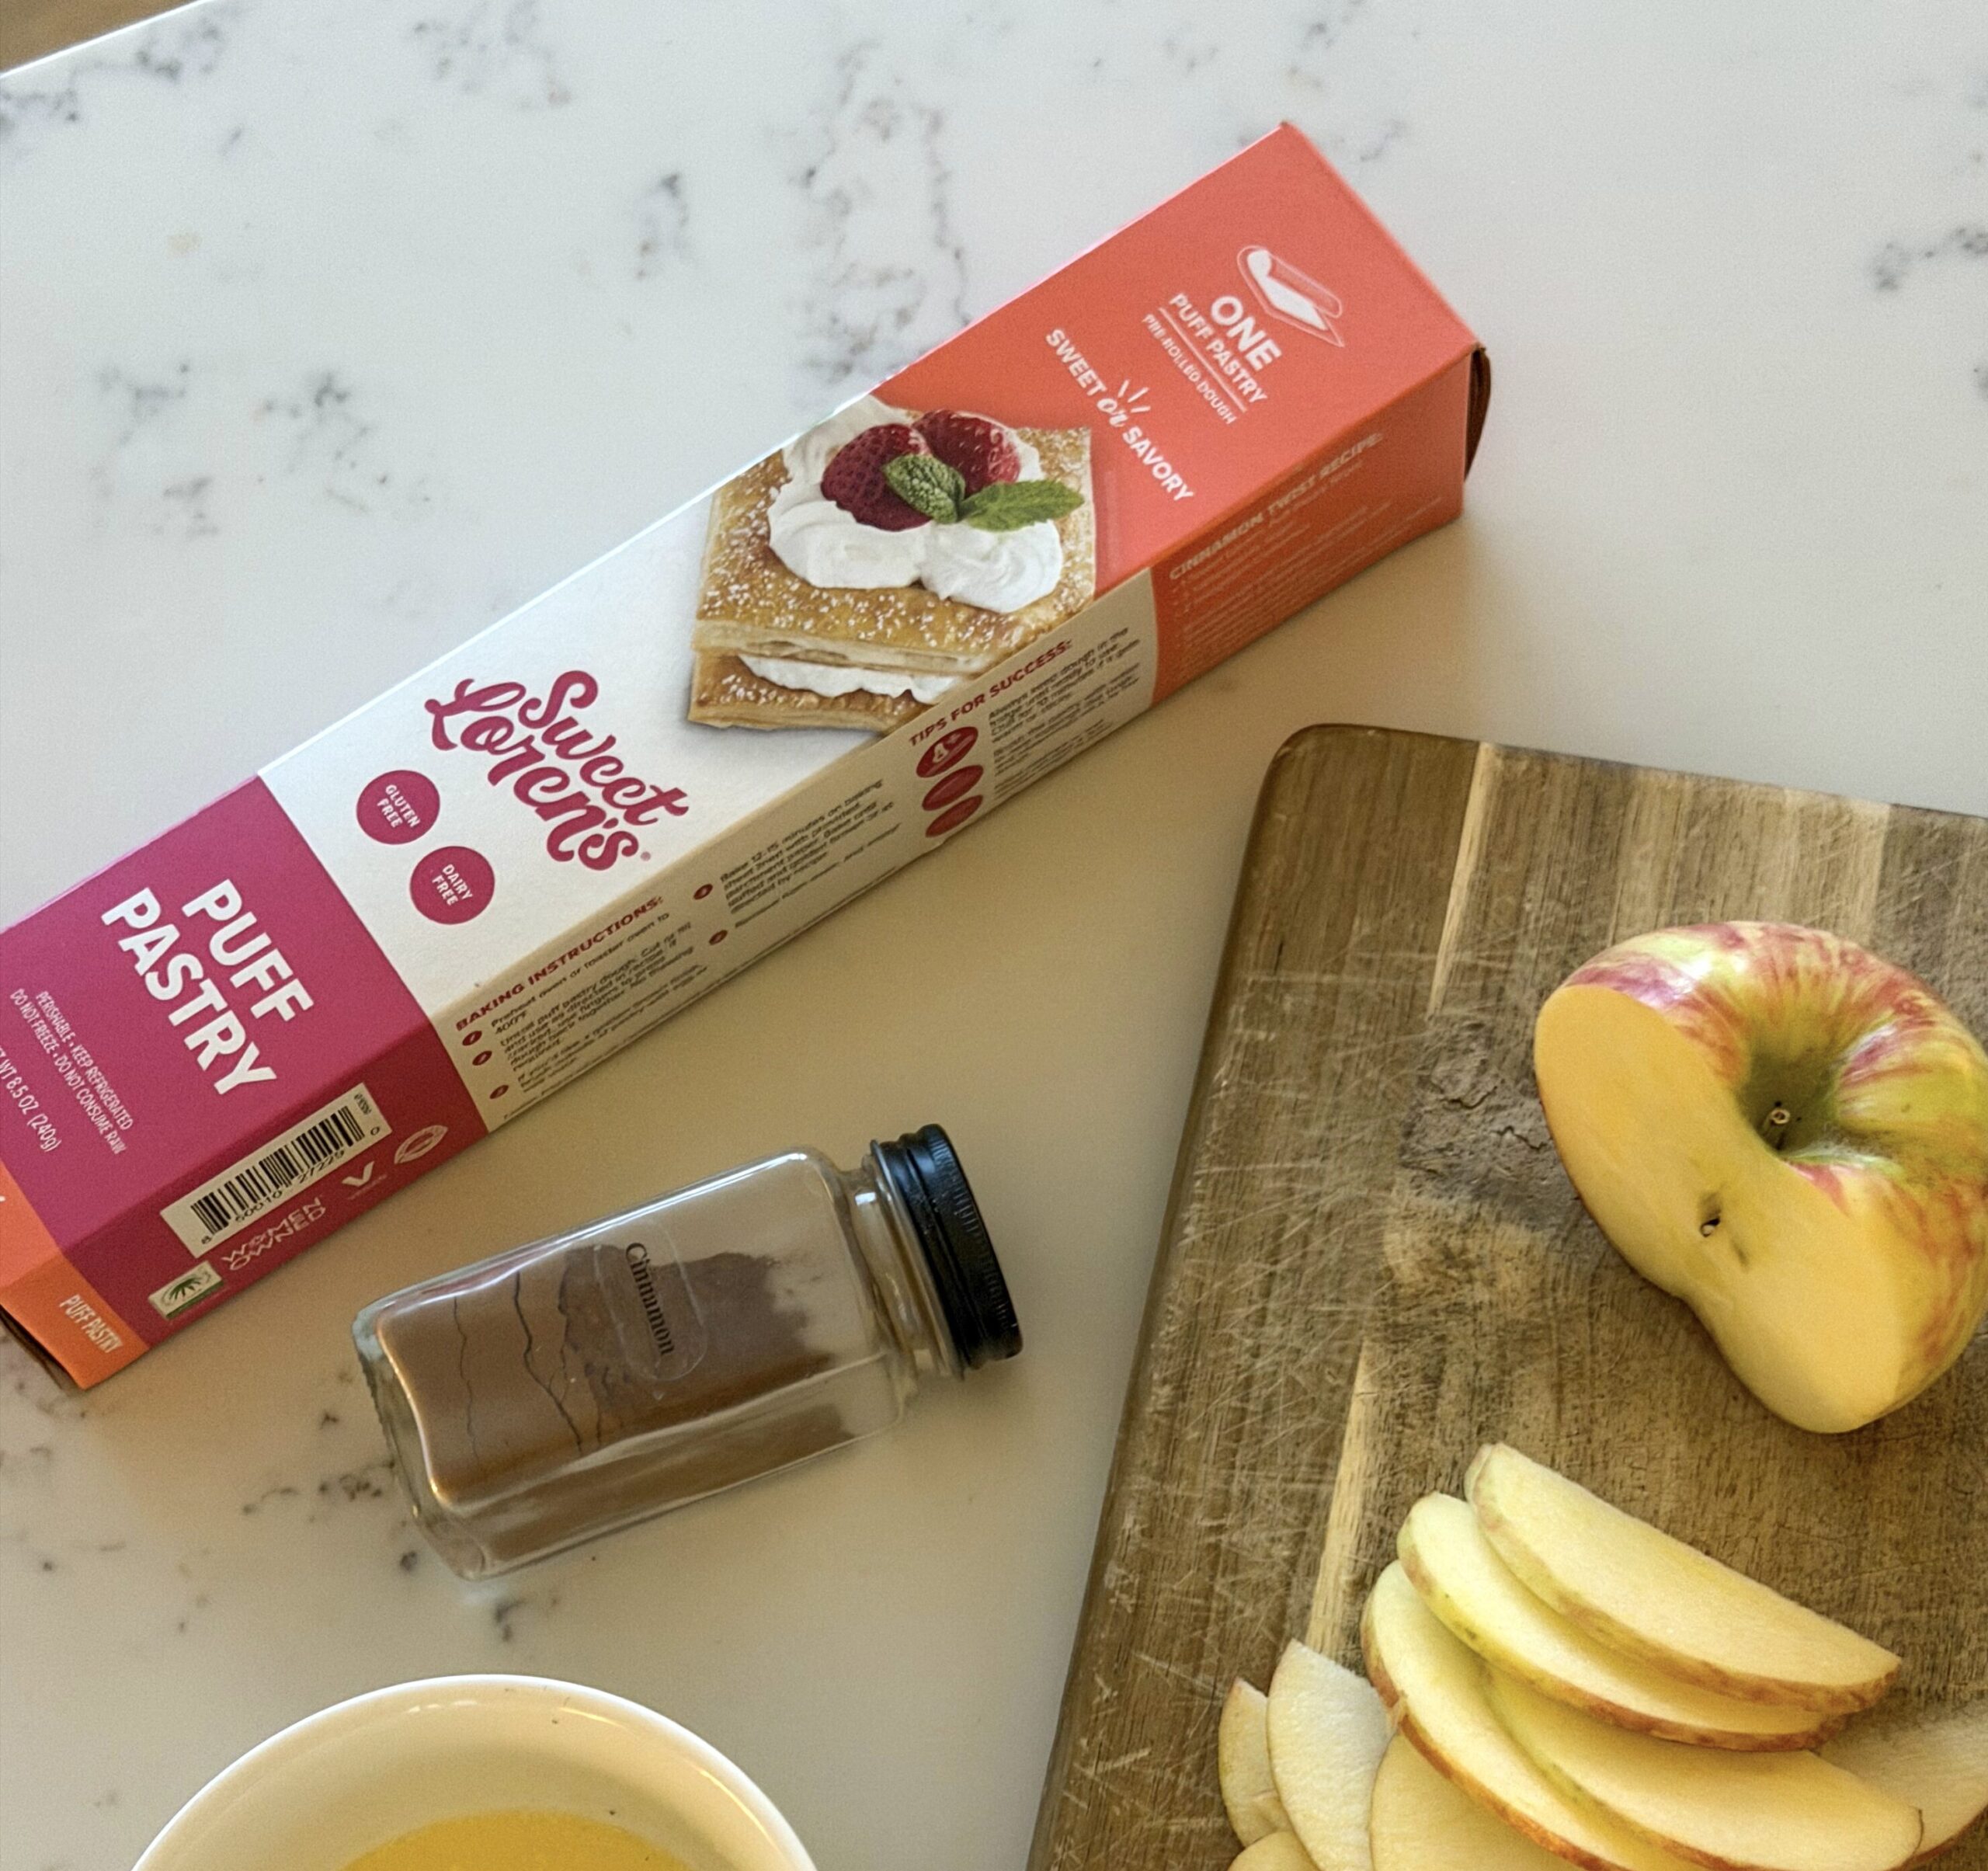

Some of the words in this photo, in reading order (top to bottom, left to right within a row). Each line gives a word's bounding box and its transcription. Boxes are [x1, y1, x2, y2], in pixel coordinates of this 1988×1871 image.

[1142, 314, 1201, 383] PRE-ROLLED
[1196, 381, 1238, 425] DOUGH
[1169, 293, 1214, 338] PUFF
[1205, 339, 1267, 404] PASTRY
[1211, 296, 1282, 371] ONE
[1045, 329, 1108, 397] SWEET
[1097, 398, 1129, 427] or
[1122, 426, 1194, 501] SAVORY
[1170, 513, 1263, 579] CINNAMON
[1267, 475, 1315, 515] TWIST
[910, 718, 947, 746] TIPS
[951, 694, 985, 721] FOR
[990, 640, 1072, 697] SUCCESS:
[424, 678, 640, 871] Loren's
[518, 670, 690, 826] Sweet
[377, 798, 403, 828] FREE
[385, 784, 421, 828] GLUTEN
[432, 875, 458, 906] FREE
[443, 864, 473, 900] DAIRY
[101, 887, 277, 1095] PASTRY
[181, 878, 314, 1022] PUFF
[457, 984, 524, 1031] BAKING
[528, 896, 662, 985] INSTRUCTIONS:
[492, 996, 536, 1027] Preheat
[539, 978, 567, 998] oven
[570, 969, 580, 977] or
[584, 941, 623, 968] toaster
[627, 922, 655, 941] oven
[657, 913, 669, 922] to
[0, 1059, 17, 1080] WT
[6, 1076, 29, 1099] 8.5
[10, 988, 28, 1006] DO
[20, 1002, 41, 1028] NOT
[31, 1020, 60, 1054] FREEZE
[54, 1053, 72, 1073] DO
[64, 1069, 85, 1090] NOT
[76, 1089, 113, 1135] CONSUME
[104, 1130, 127, 1155] RAW
[18, 1095, 39, 1115] OZ
[36, 991, 75, 1042] PERISHABLE
[71, 1044, 93, 1067] KEEP
[84, 1066, 134, 1130] REFRIGERATED
[26, 1113, 61, 1153] (240g)
[201, 1235, 212, 1245] 8
[235, 1190, 283, 1222] 50010
[297, 1150, 345, 1184] 27229
[370, 1127, 381, 1136] 0
[221, 1197, 322, 1262] WOMEN
[230, 1207, 326, 1271] OWNED
[59, 1293, 96, 1323] PUFF
[81, 1316, 123, 1353] PASTRY
[626, 1242, 675, 1355] Cinnamon
